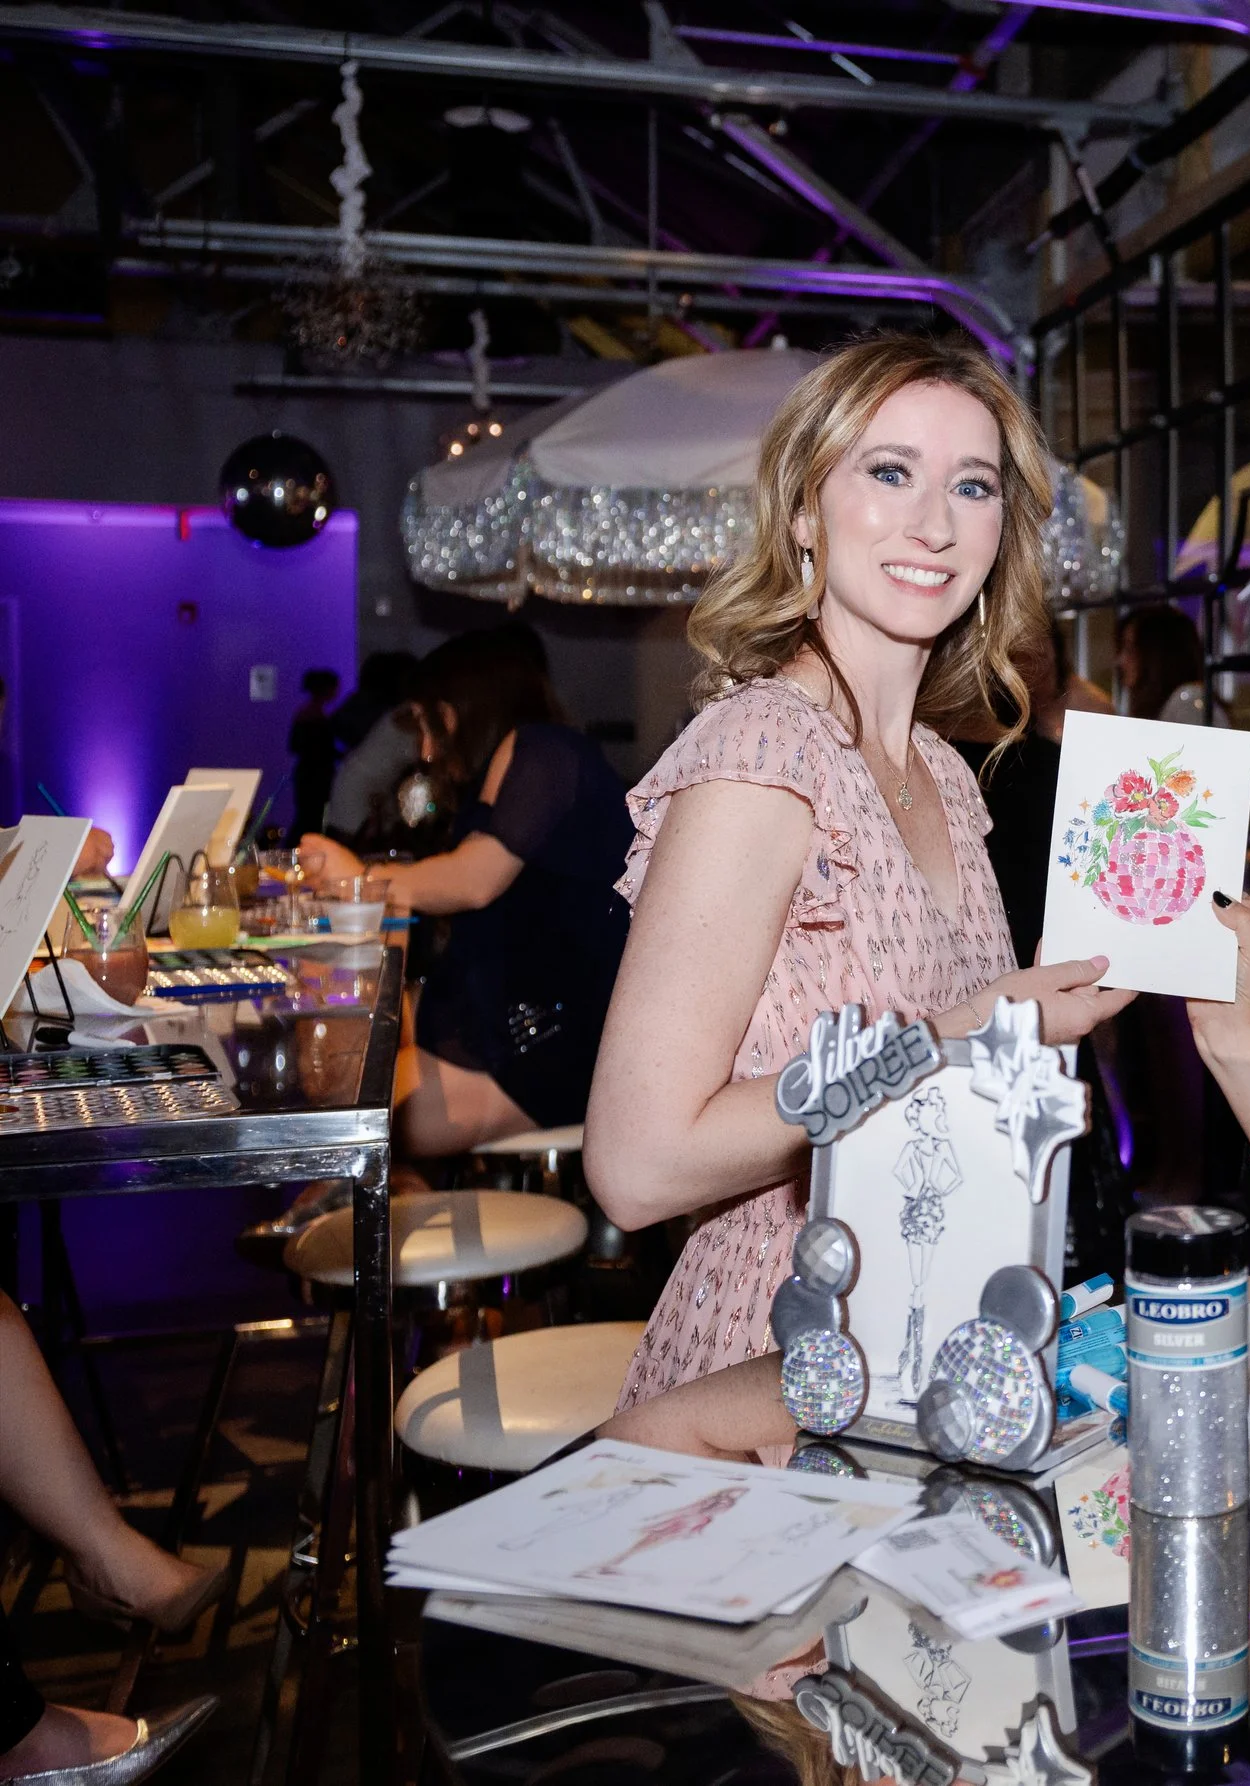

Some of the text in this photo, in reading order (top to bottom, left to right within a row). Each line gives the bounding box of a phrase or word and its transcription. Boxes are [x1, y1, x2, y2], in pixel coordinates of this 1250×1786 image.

[777, 1003, 897, 1114] Silver
[1138, 1300, 1223, 1319] LEOBRO
[1152, 1332, 1205, 1348] SILVER
